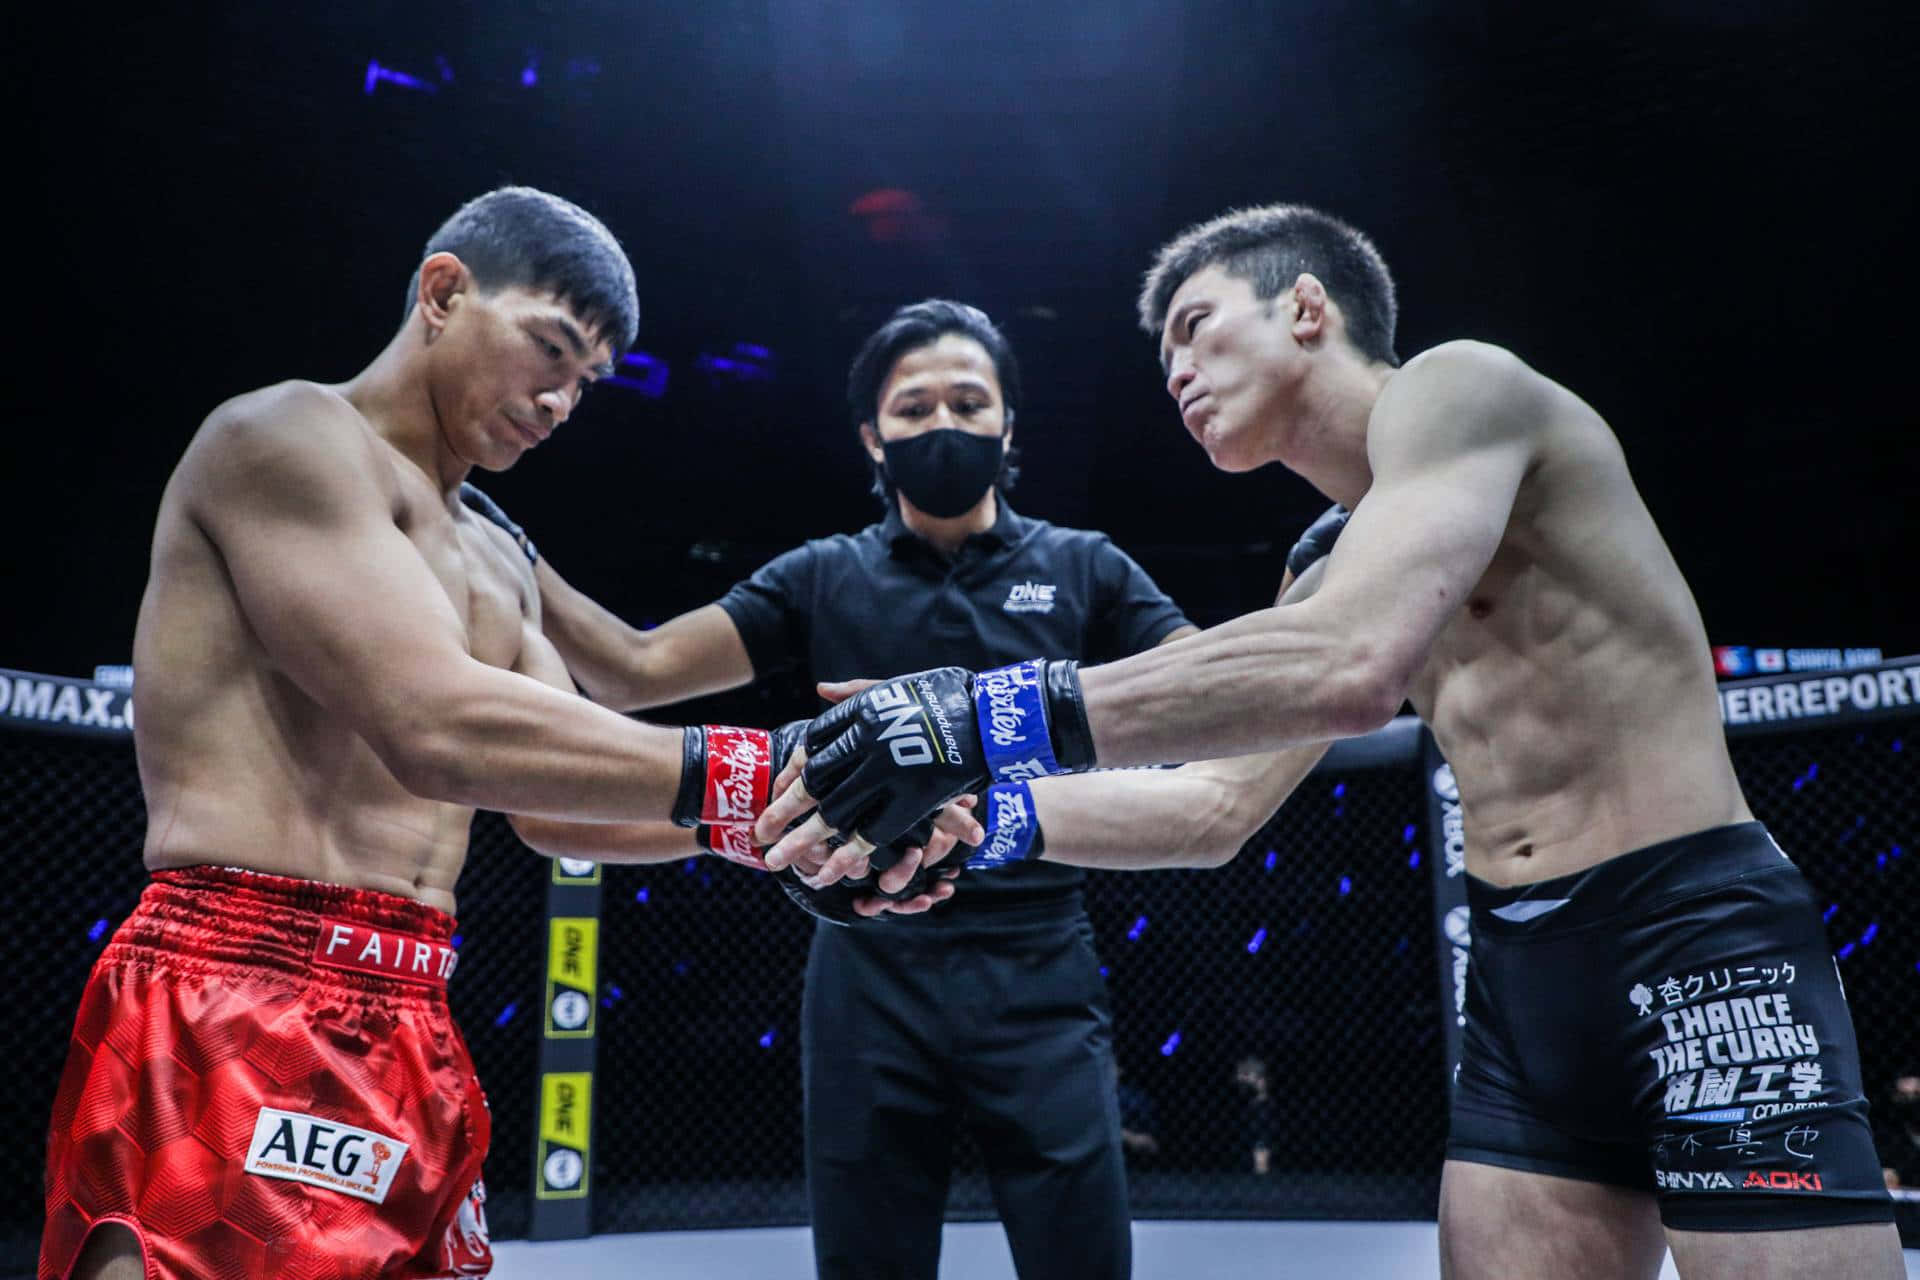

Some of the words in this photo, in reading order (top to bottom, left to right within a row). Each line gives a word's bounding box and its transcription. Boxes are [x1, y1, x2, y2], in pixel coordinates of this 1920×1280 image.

[1009, 580, 1056, 601] ONE
[982, 667, 1027, 746] Fairtex
[1718, 666, 1920, 724] ERREPORT
[869, 682, 934, 767] ONE
[561, 926, 583, 978] ONE
[1656, 962, 1796, 1006] 杏クリニック
[1661, 993, 1793, 1041] CHANCE
[1649, 1042, 1704, 1078] THE
[1708, 1025, 1820, 1065] CURRY
[553, 1081, 577, 1136] ONE
[1664, 1061, 1823, 1113] 格闘工学
[259, 1118, 367, 1176] AEG
[1655, 1169, 1734, 1190] SHINYA
[1743, 1170, 1823, 1192] AOKI
